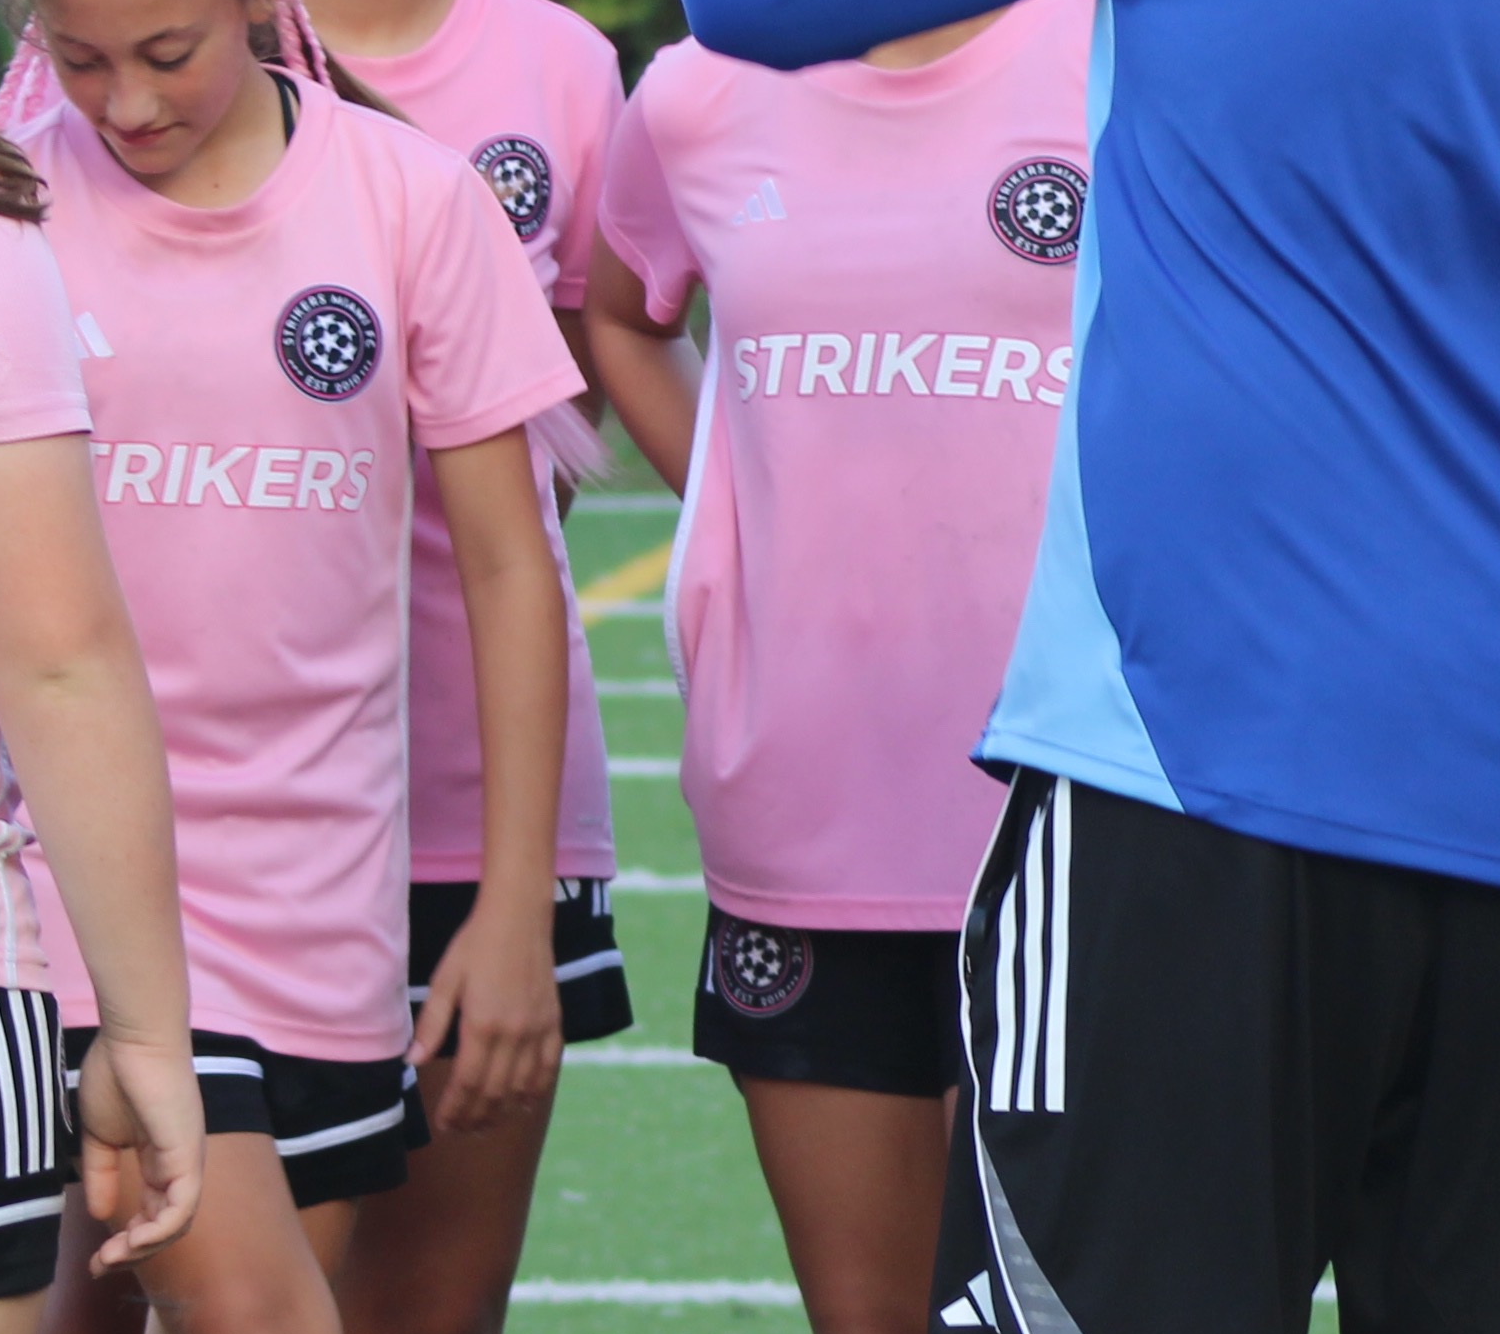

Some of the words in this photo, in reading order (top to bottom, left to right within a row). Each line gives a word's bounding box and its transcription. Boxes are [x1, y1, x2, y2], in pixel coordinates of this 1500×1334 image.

[995, 163, 1046, 209] STRIKERS
[1014, 235, 1041, 255] EST
[1045, 242, 1076, 258] 2010
[282, 292, 328, 347] STRIKERS
[304, 374, 330, 394] EST
[334, 373, 362, 394] 2010
[734, 332, 1074, 407] STRIKERS
